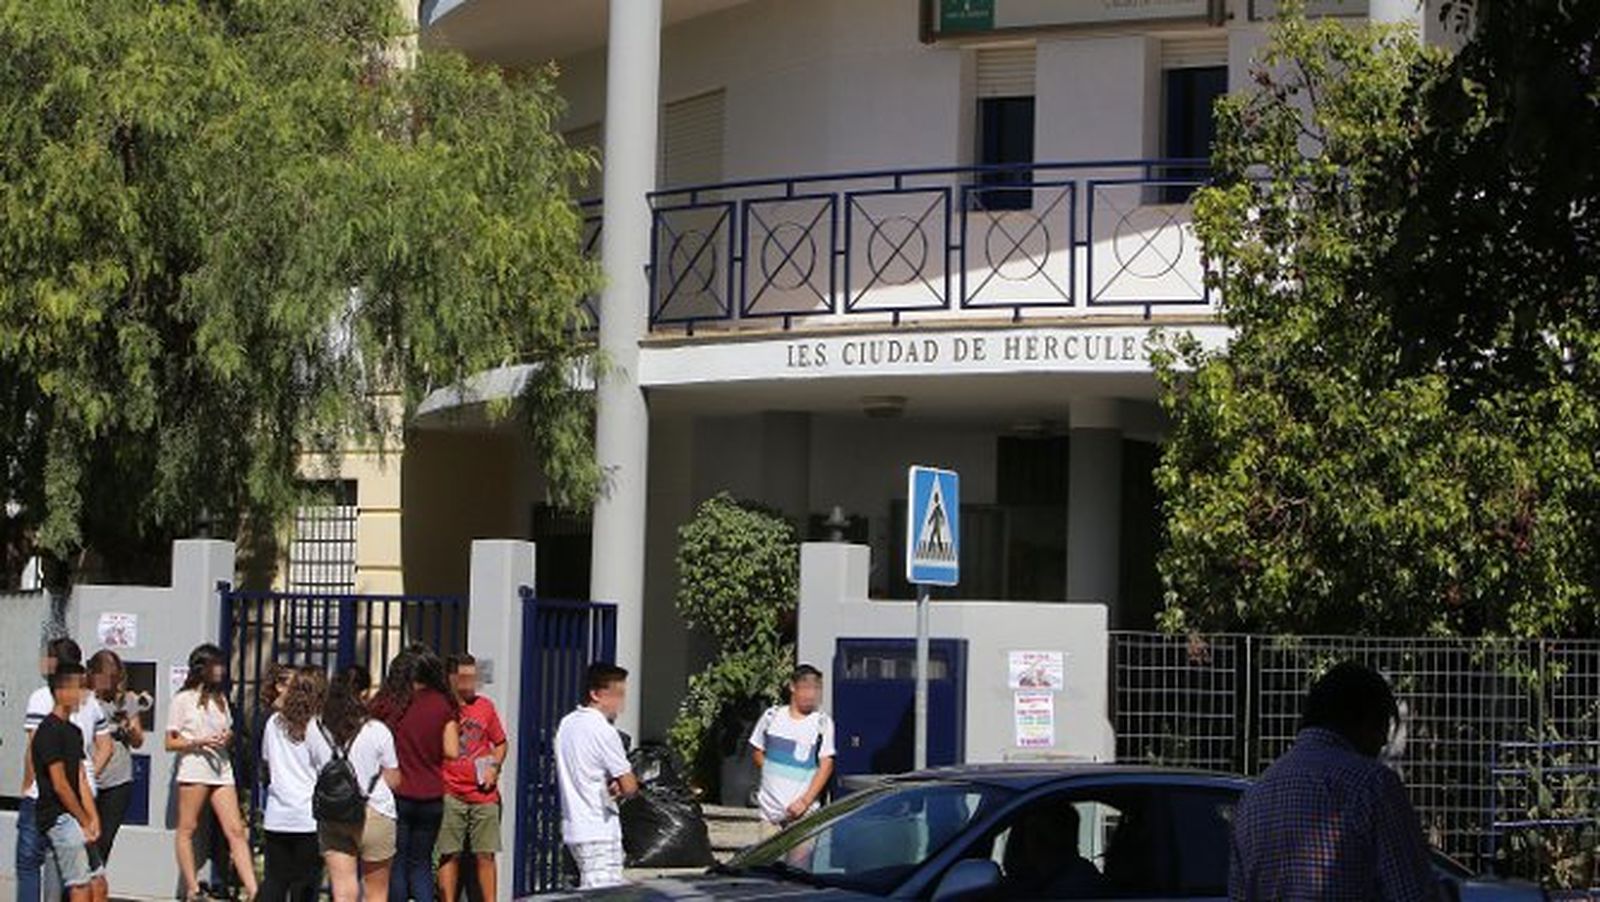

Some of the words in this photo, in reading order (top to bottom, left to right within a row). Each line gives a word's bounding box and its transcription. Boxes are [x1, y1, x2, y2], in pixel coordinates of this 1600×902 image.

[842, 339, 940, 365] CIUDAD
[953, 336, 987, 362] DE
[1003, 335, 1152, 361] HERCULES
